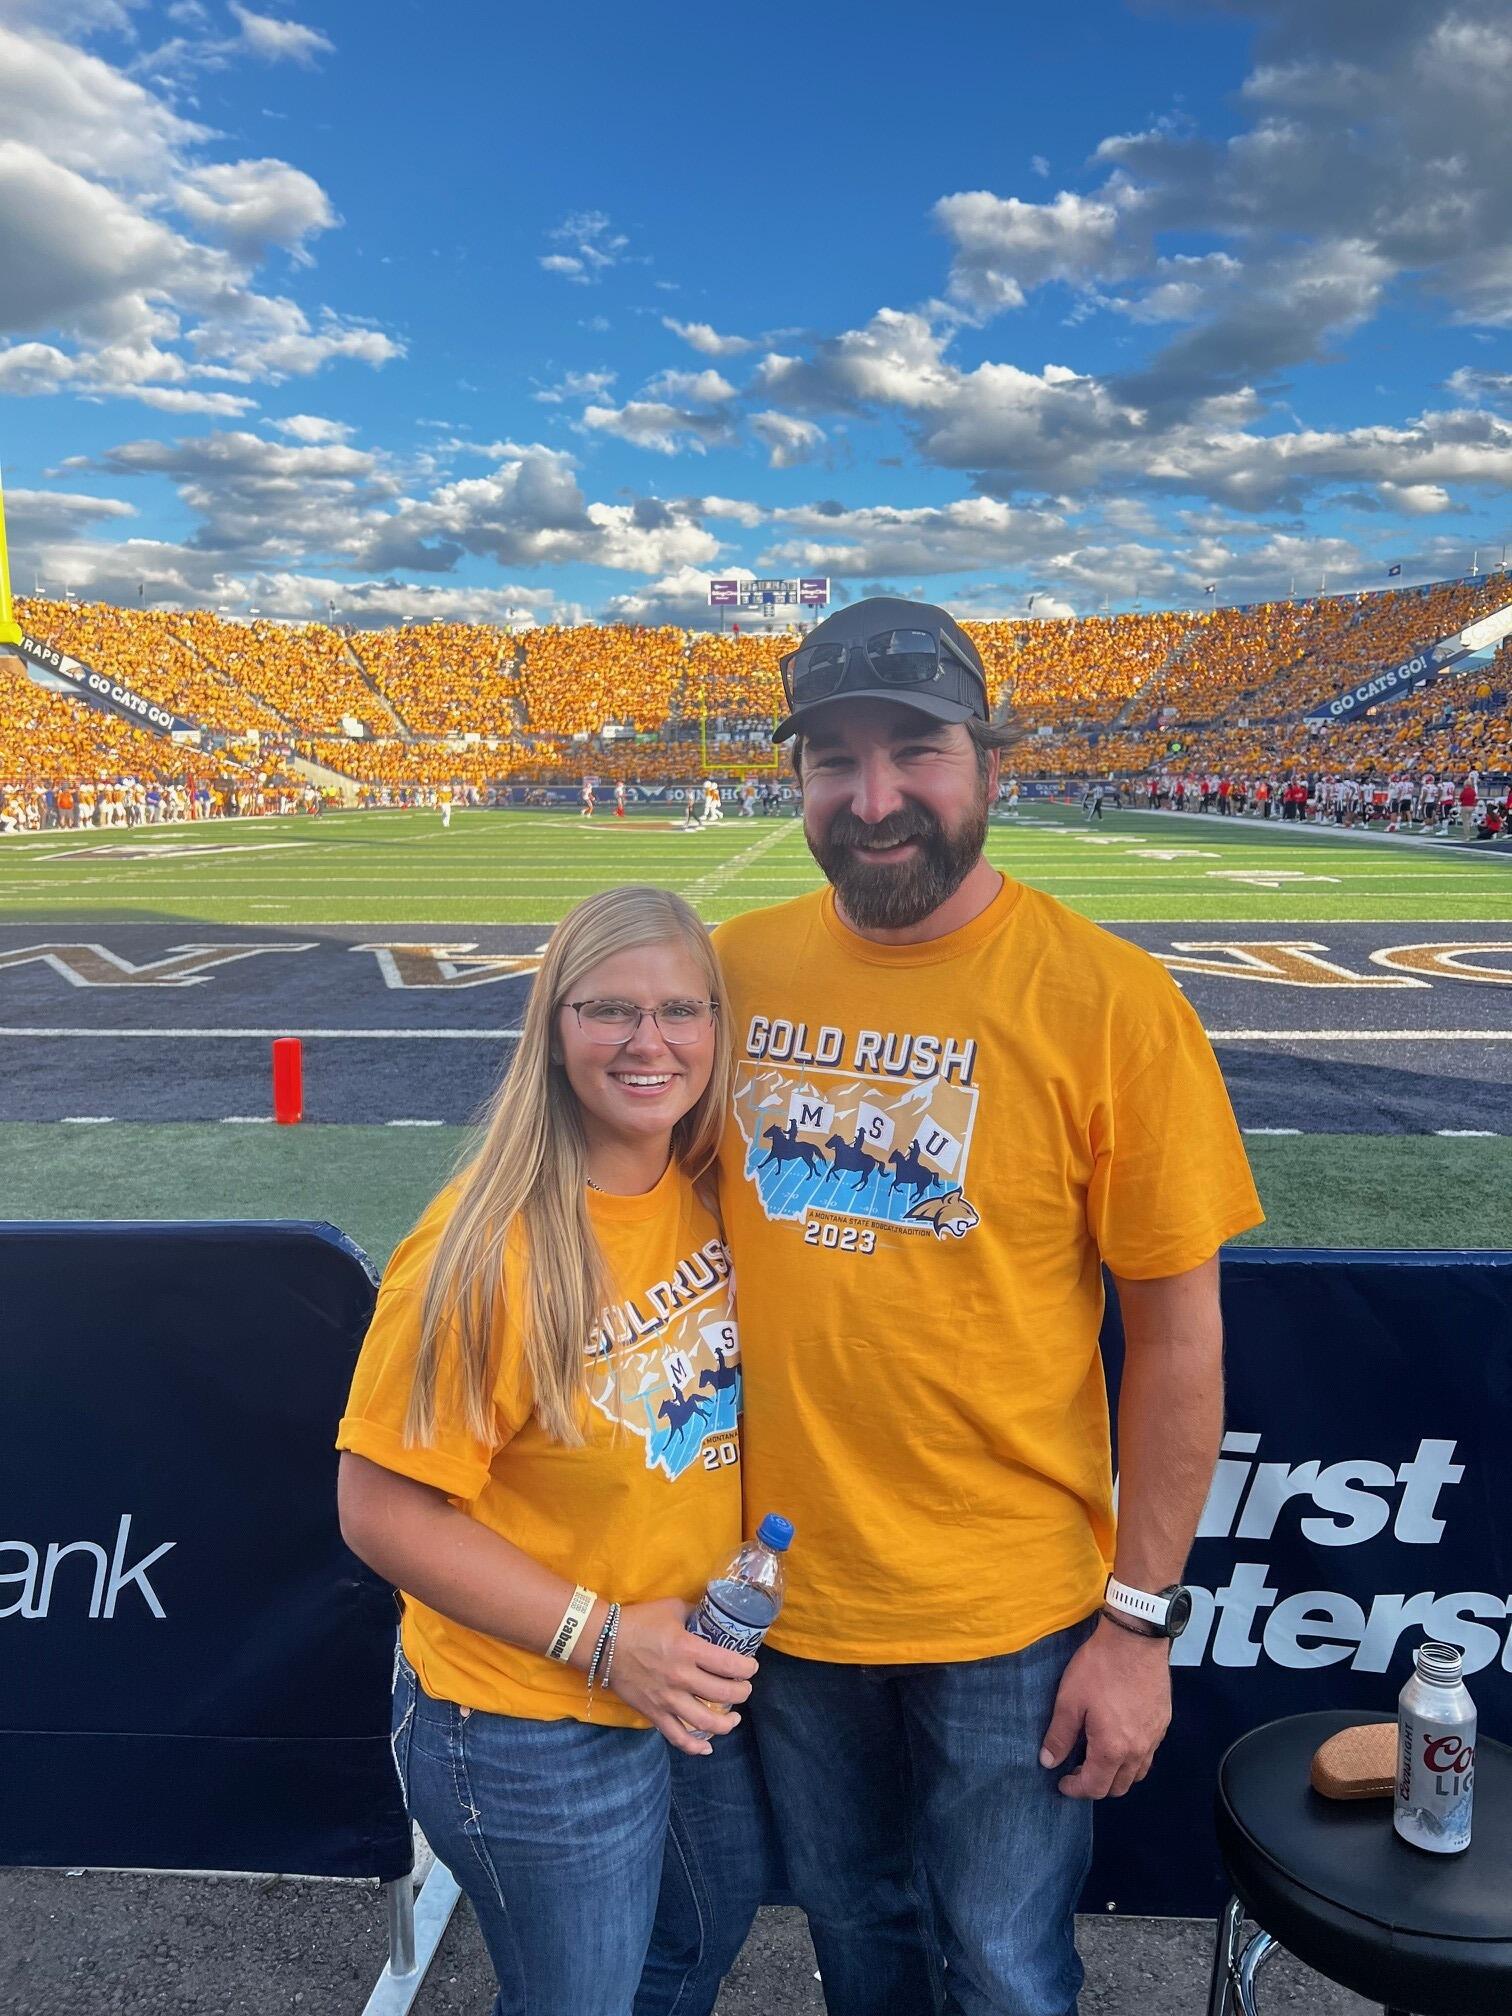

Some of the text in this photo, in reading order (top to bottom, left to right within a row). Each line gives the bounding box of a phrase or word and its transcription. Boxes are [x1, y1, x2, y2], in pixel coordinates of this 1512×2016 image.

[19, 637, 61, 667] RAPS
[88, 674, 175, 730] GO CATS GO!
[1330, 656, 1427, 716] GO CATS GO!
[746, 1015, 978, 1086] GOLD RUSH
[800, 1104, 949, 1157] M S U
[804, 1220, 877, 1256] 2023
[815, 1211, 848, 1224] MONTANA
[849, 1218, 870, 1228] STATE
[896, 1227, 931, 1237] TRADITION
[670, 1327, 735, 1384] M S
[1196, 1431, 1466, 1546] irst
[0, 1513, 178, 1619] ank
[1169, 1562, 1512, 1677] nters
